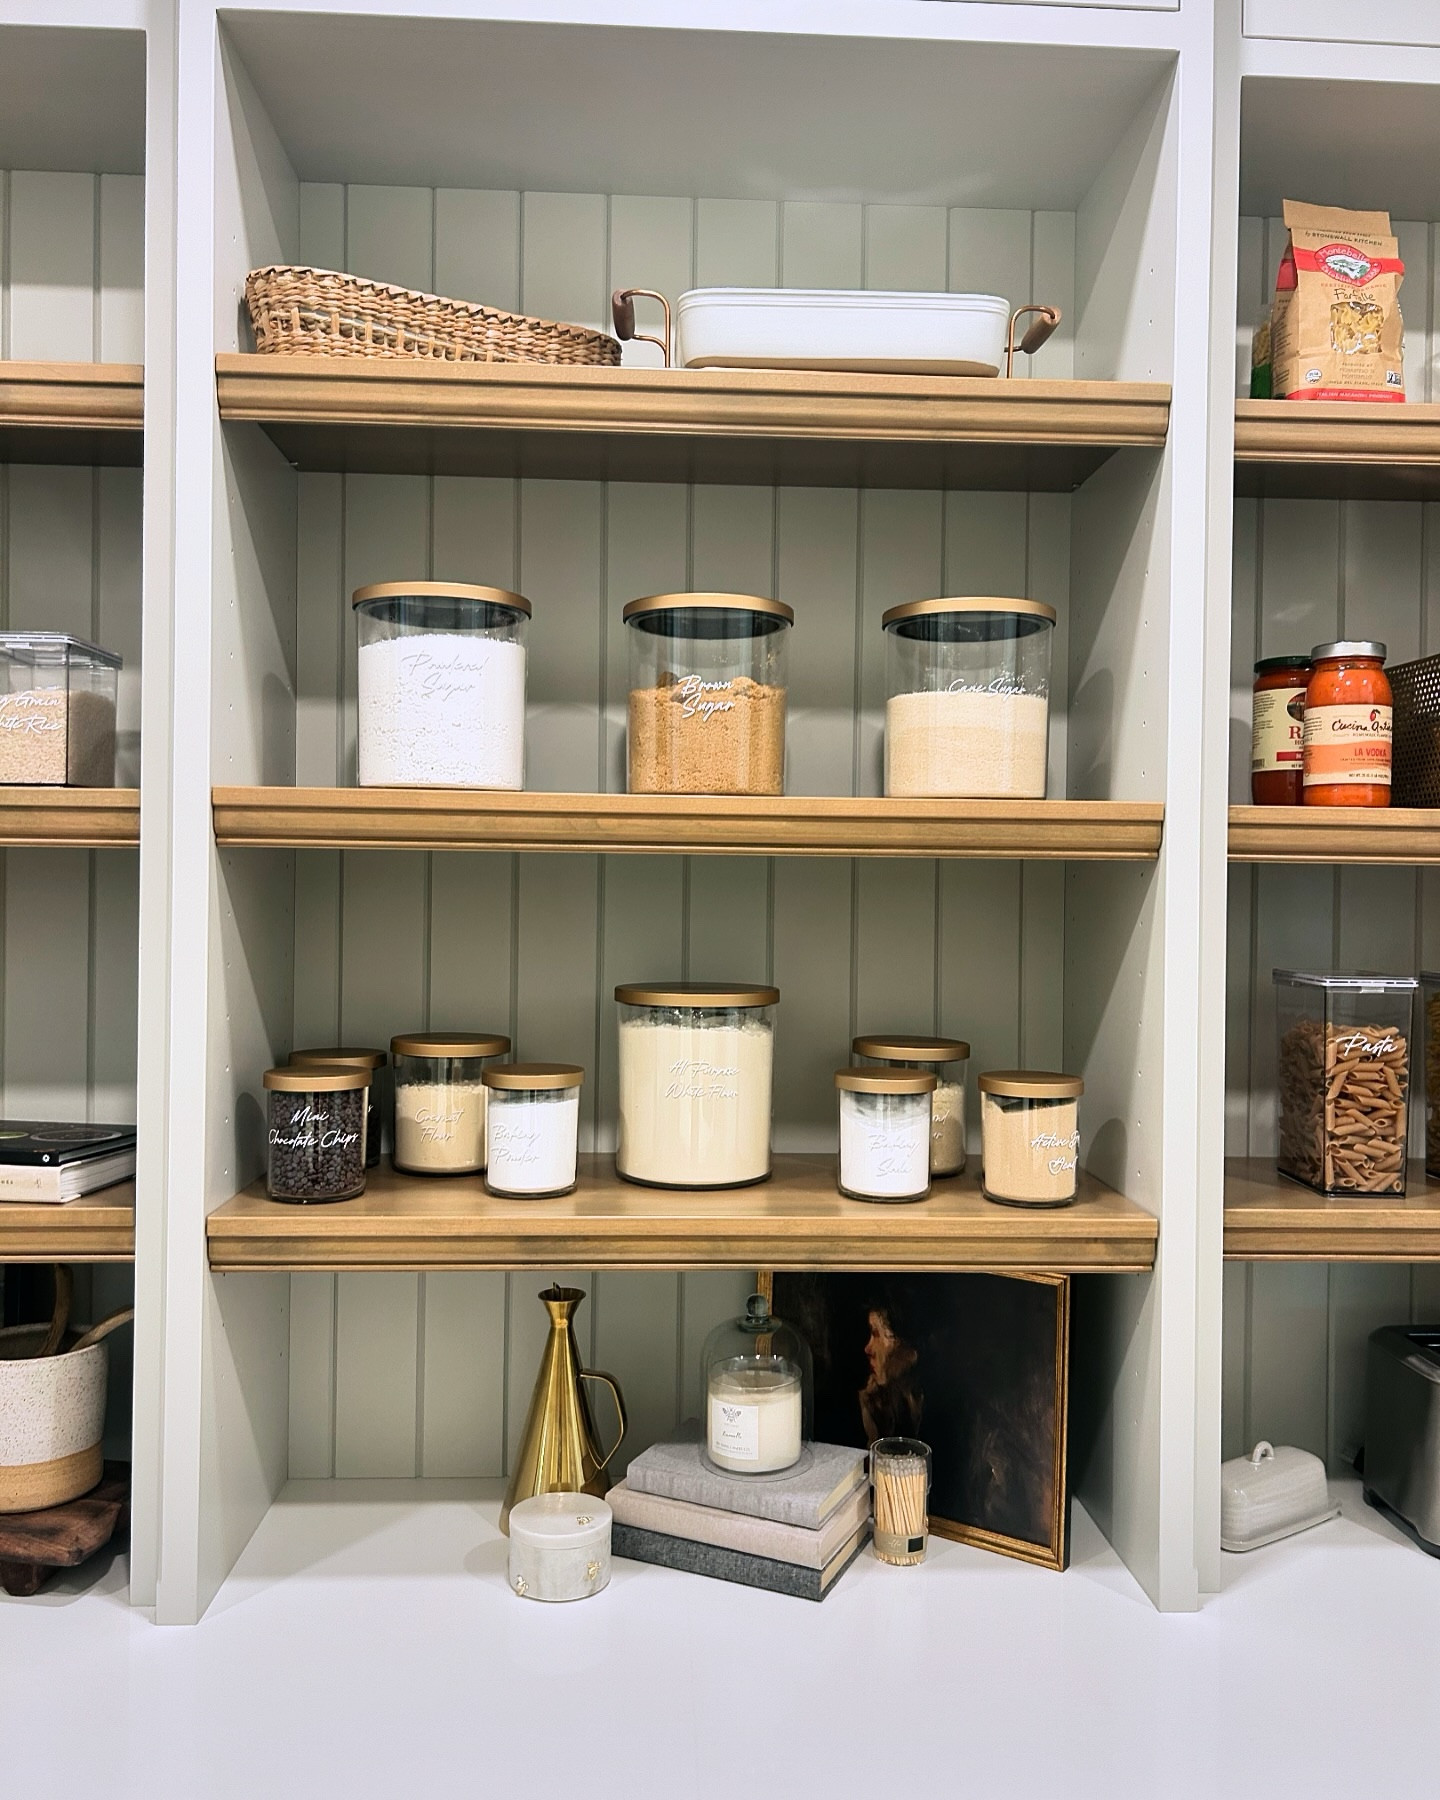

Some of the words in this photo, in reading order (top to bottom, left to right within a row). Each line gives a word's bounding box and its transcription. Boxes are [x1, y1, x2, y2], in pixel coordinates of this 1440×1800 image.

[1312, 232, 1352, 242] STONEWALL
[1354, 237, 1383, 246] KITCHEN
[1333, 287, 1377, 301] Farfalle
[421, 672, 476, 702] Sugar
[678, 674, 733, 697] Brown
[948, 678, 987, 696] Cane
[988, 677, 1027, 702] Sugar
[14, 690, 60, 708] Grain
[682, 692, 735, 722] Sugar
[22, 714, 62, 734] Rice
[1332, 719, 1368, 731] Cucina
[1354, 748, 1363, 757] LA
[1366, 748, 1387, 757] VODKA
[1336, 1032, 1398, 1057] Pasta
[688, 1060, 740, 1081] Purpose
[665, 1082, 706, 1100] White
[708, 1085, 739, 1100] Flour
[289, 1105, 330, 1127] Mini
[414, 1107, 465, 1125] Coconut
[268, 1129, 319, 1149] Chocolate
[320, 1129, 359, 1149] Chips
[421, 1126, 455, 1144] Flour
[492, 1124, 541, 1147] Baking
[1031, 1132, 1068, 1150] Active
[868, 1134, 921, 1157] Baking
[490, 1146, 540, 1165] Powder
[876, 1158, 912, 1177] Soda
